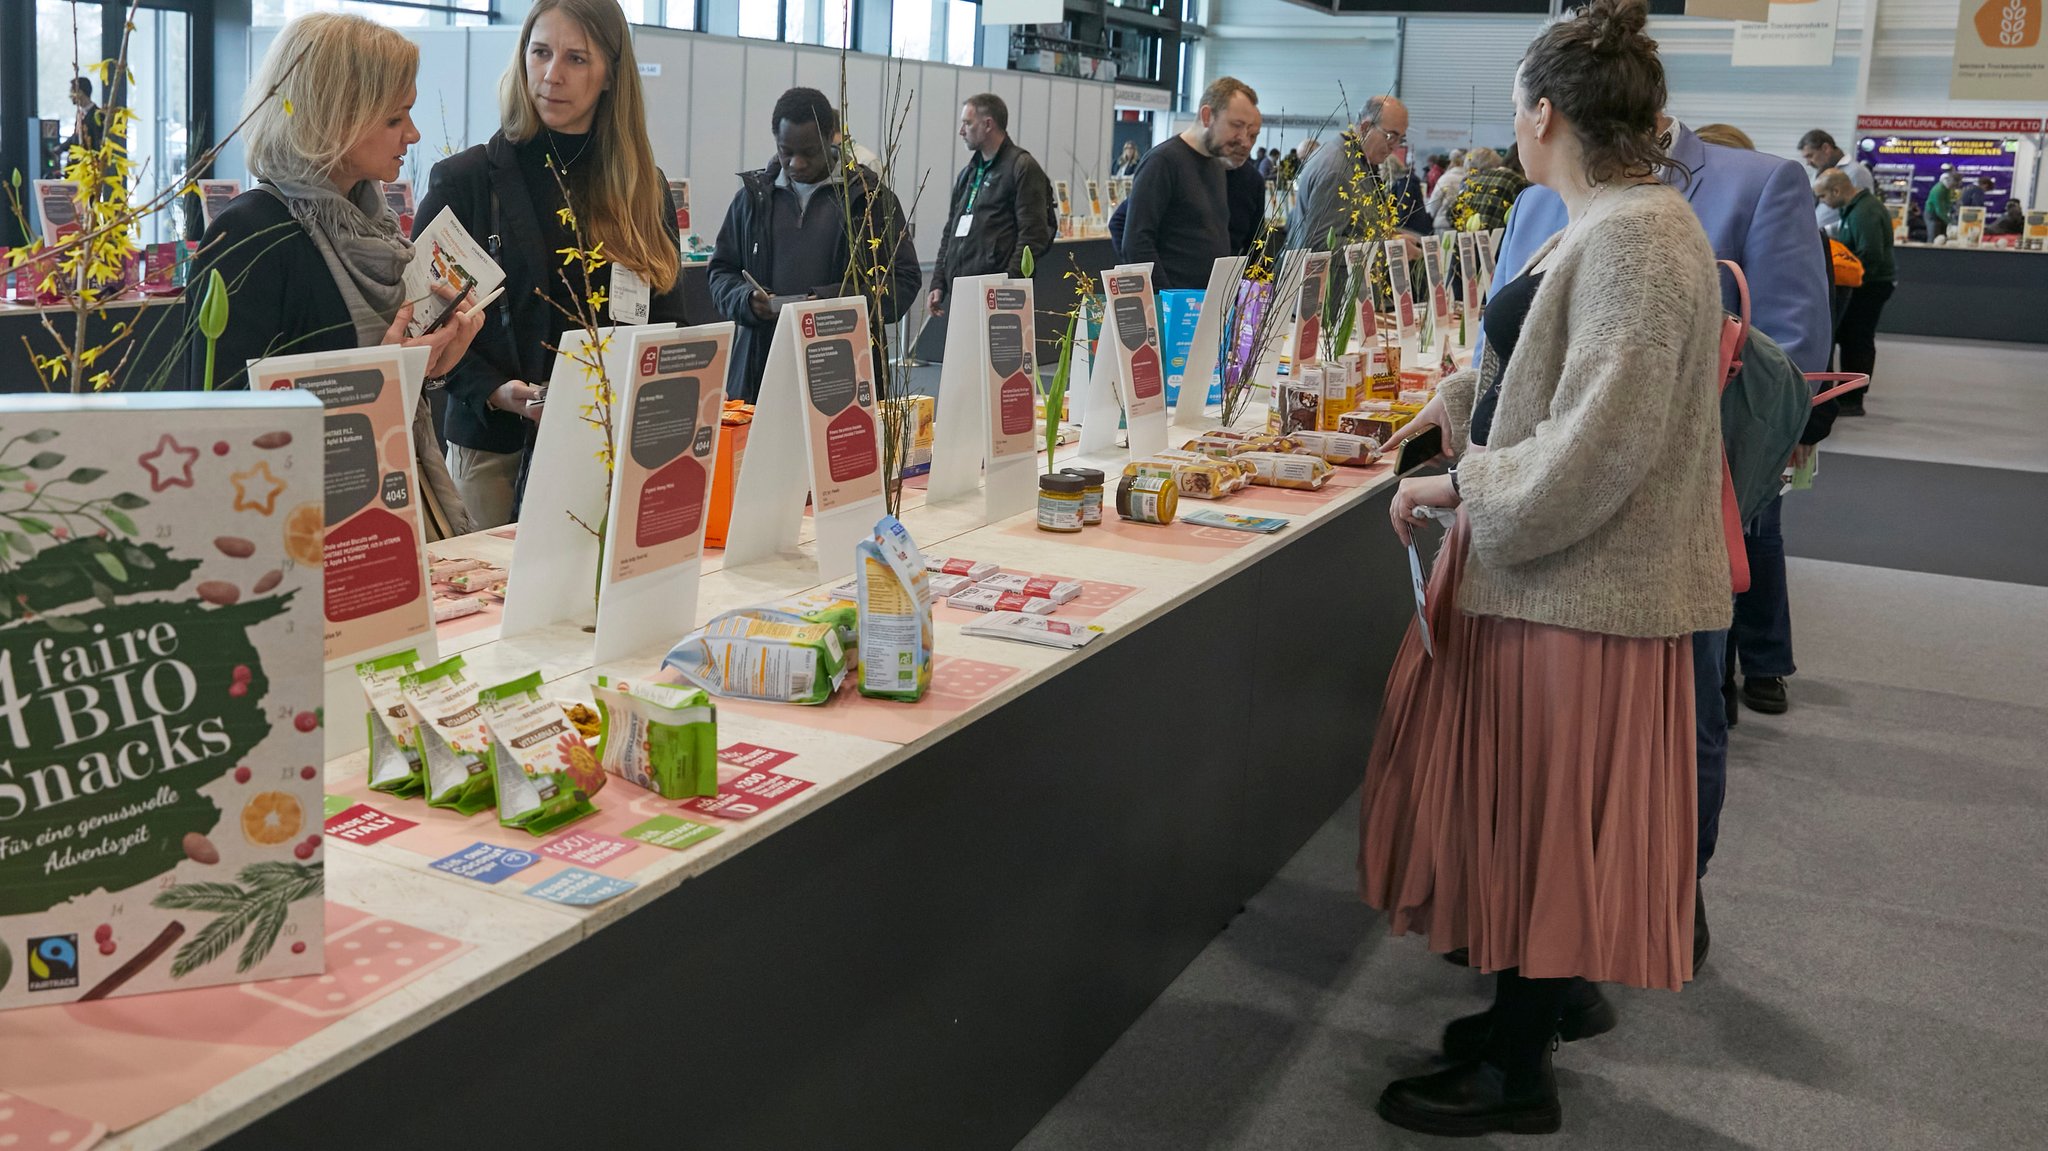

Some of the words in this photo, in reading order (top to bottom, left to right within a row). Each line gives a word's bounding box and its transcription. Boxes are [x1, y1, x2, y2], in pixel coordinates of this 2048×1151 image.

[1858, 117, 1893, 128] ROSUN
[1894, 118, 1939, 129] NATURAL
[1941, 119, 1996, 130] PRODUCTS
[1999, 121, 2019, 130] PVT
[2020, 121, 2040, 130] LTD
[386, 488, 407, 502] 4045
[155, 525, 172, 538] 23
[28, 622, 179, 692] faire
[40, 658, 197, 750] BIO
[518, 729, 556, 748] VITAMINA
[554, 725, 561, 734] D
[0, 716, 232, 820] Snacks
[726, 803, 759, 814] D
[0, 835, 32, 861] Für
[36, 824, 75, 847] eine
[78, 785, 180, 838] genussvolle
[325, 817, 362, 834] MADE
[360, 811, 379, 821] IN
[340, 816, 396, 839] ITALY
[44, 823, 150, 875] Adventszeit
[452, 848, 507, 874] Coconut
[159, 875, 177, 889] 22
[30, 977, 77, 990] FAIRTRADE
